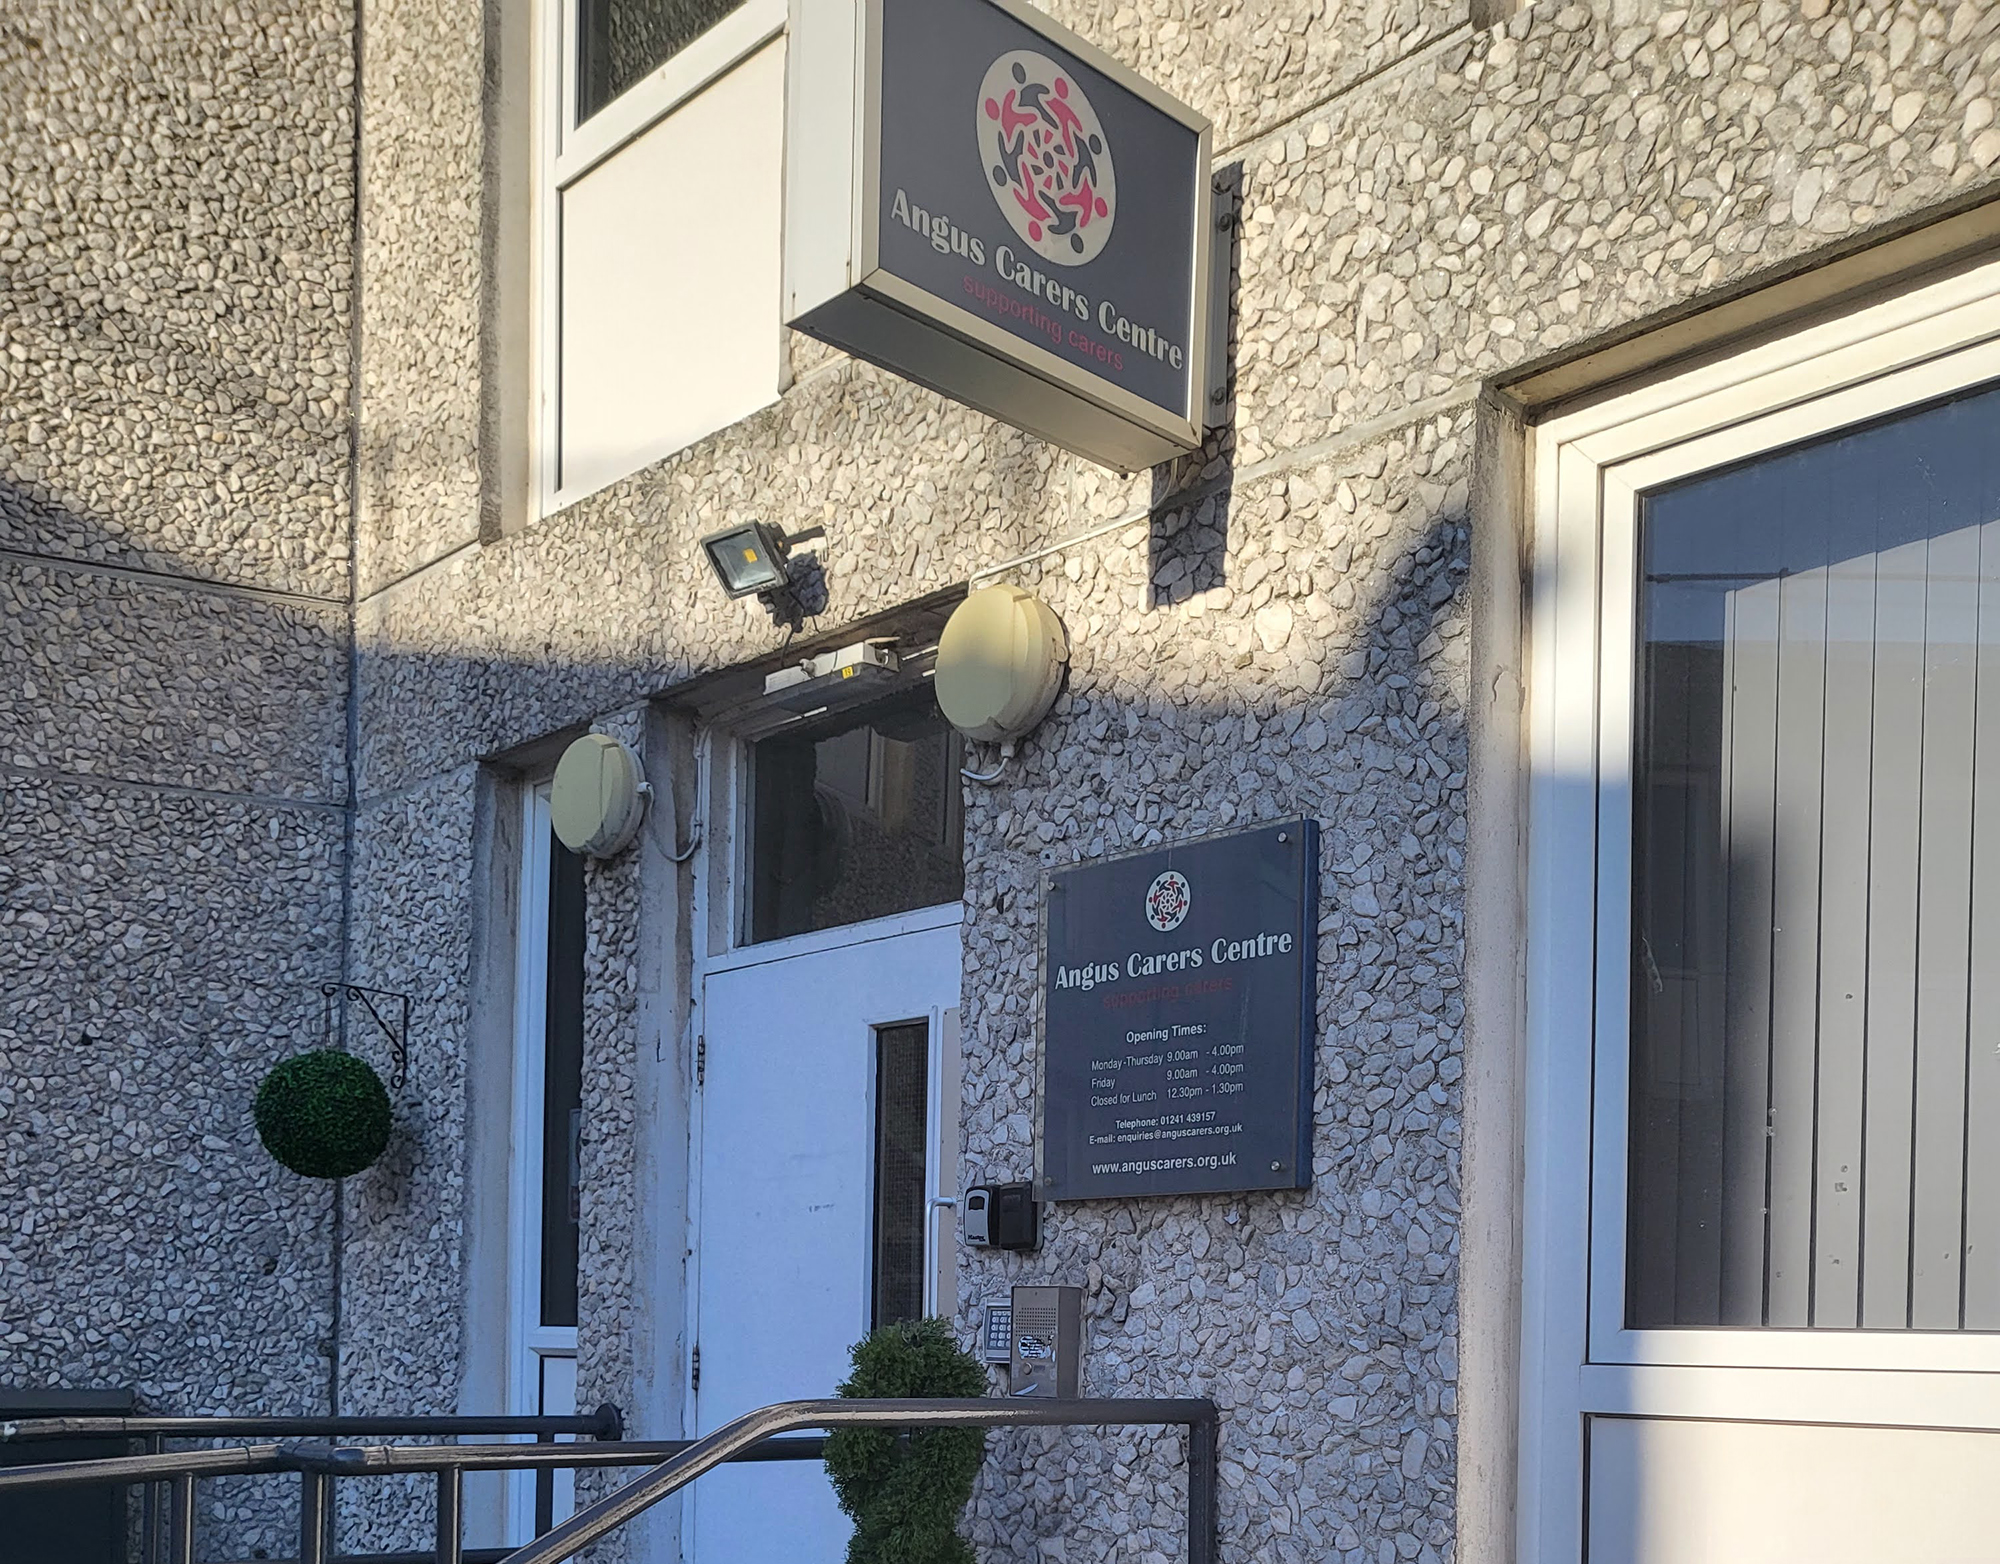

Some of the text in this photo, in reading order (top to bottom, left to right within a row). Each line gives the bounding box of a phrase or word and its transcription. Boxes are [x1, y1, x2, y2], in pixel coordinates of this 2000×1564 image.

[890, 188, 1184, 371] Angus Carers Centre
[963, 275, 1124, 371] supporting carers
[1055, 932, 1292, 991] Angus Carers Centre
[1103, 977, 1233, 1009] supporting carers
[1126, 1024, 1207, 1045] Opening Times:
[1166, 1049, 1199, 1062] 9.00am
[1211, 1044, 1245, 1057] 4.00pm
[1091, 1077, 1116, 1089] Friday
[1166, 1068, 1198, 1081] 9.00am
[1211, 1063, 1244, 1076] 4.00pm
[1090, 1094, 1118, 1107] Closed
[1119, 1092, 1131, 1104] for
[1132, 1090, 1157, 1103] Lunch
[1167, 1086, 1203, 1099] 12.30pm
[1211, 1082, 1244, 1095] 1.30pm
[1115, 1111, 1216, 1130] Telephone: 01241 439157
[1089, 1122, 1243, 1145] E-mail: enquiries@anguscarers.org.uk
[1092, 1151, 1237, 1175] www.anguscarers.org.uk
